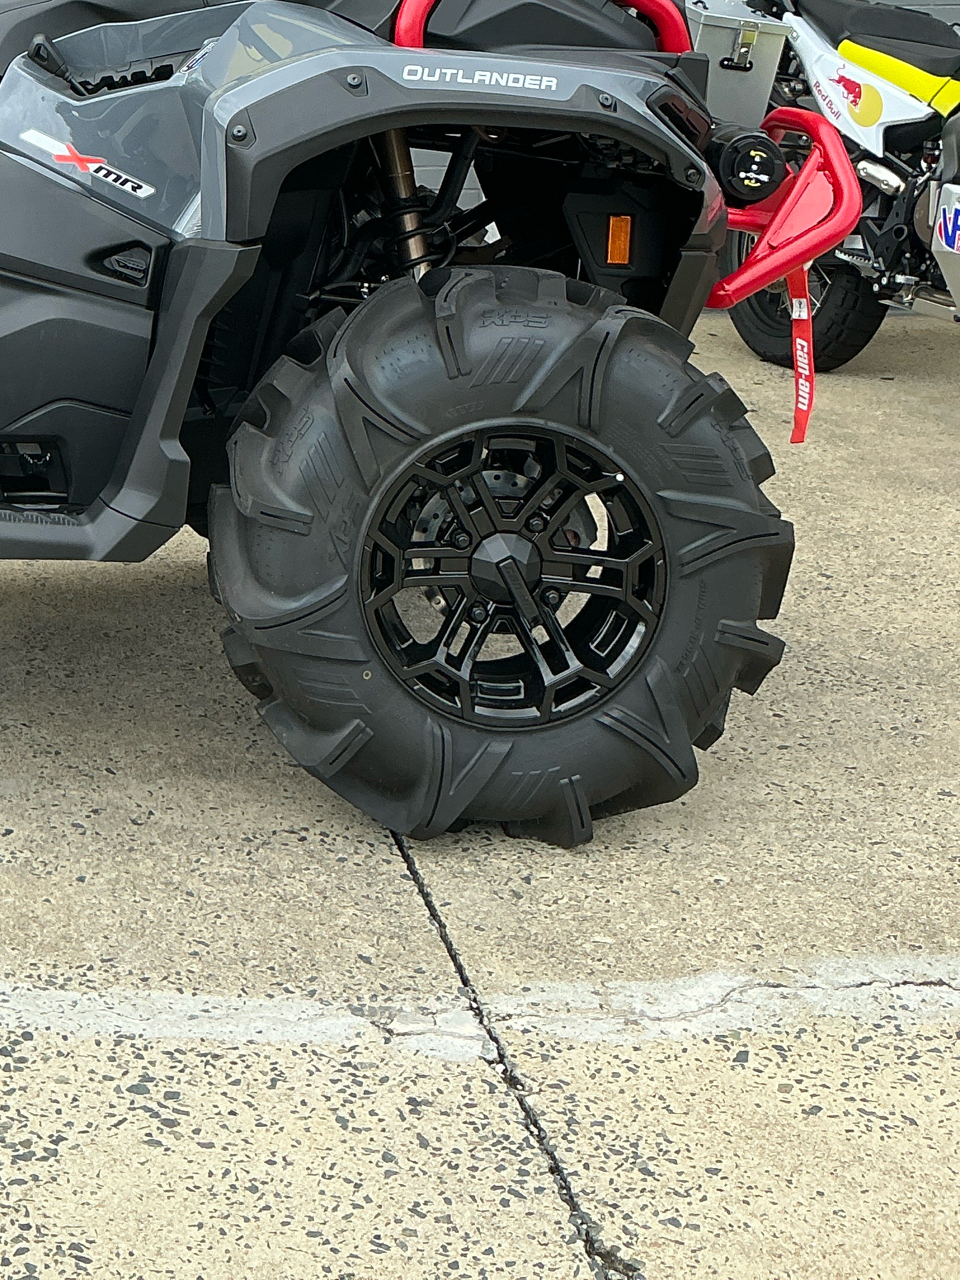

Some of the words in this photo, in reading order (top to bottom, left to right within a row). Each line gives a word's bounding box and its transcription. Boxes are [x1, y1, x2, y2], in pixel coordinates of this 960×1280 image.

[402, 64, 558, 91] OUTLANDER
[813, 80, 829, 102] Red
[825, 99, 842, 121] Bull
[795, 337, 811, 411] can-am
